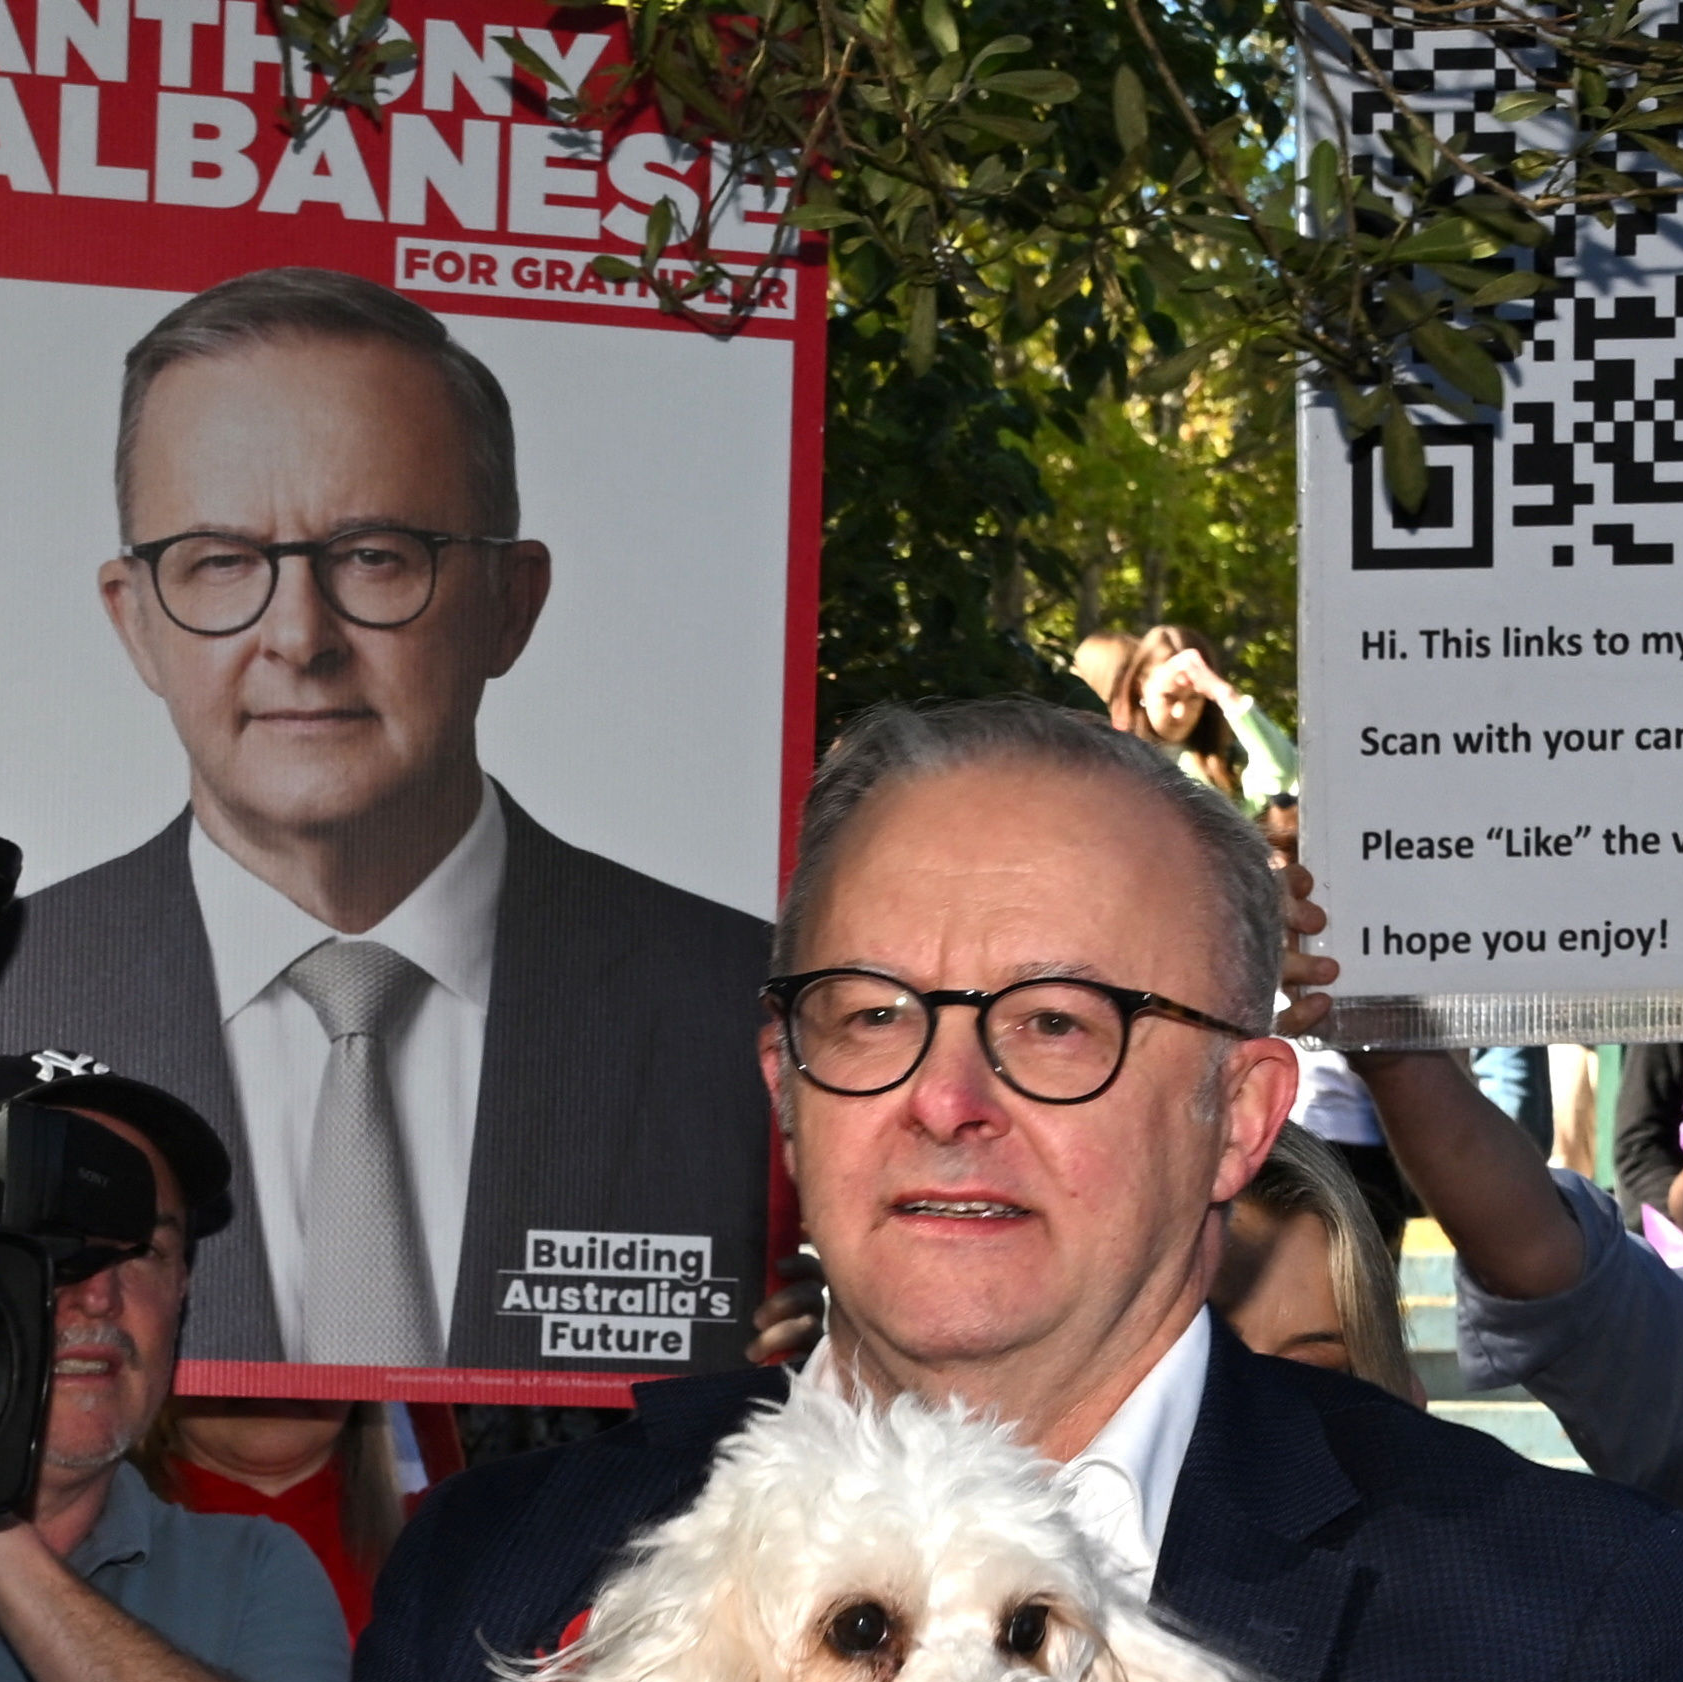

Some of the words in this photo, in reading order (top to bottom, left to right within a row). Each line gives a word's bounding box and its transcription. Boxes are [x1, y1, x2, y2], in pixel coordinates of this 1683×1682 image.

[404, 248, 498, 286] FOR
[1362, 629, 1408, 661] Hi.
[1418, 627, 1491, 660] This
[1503, 625, 1583, 658] links
[1592, 628, 1630, 656] to
[1360, 726, 1441, 757] Scan
[1452, 721, 1532, 755] with
[1542, 728, 1625, 760] your
[1362, 829, 1474, 861] Please
[1486, 824, 1592, 858] “Like”
[1602, 824, 1661, 856] the
[1362, 926, 1370, 956] I
[1383, 924, 1472, 962] hope
[1482, 930, 1546, 961] you
[1558, 918, 1668, 958] enjoy!
[532, 1236, 705, 1284] Building
[501, 1278, 732, 1318] Australia's
[548, 1320, 684, 1355] Future
